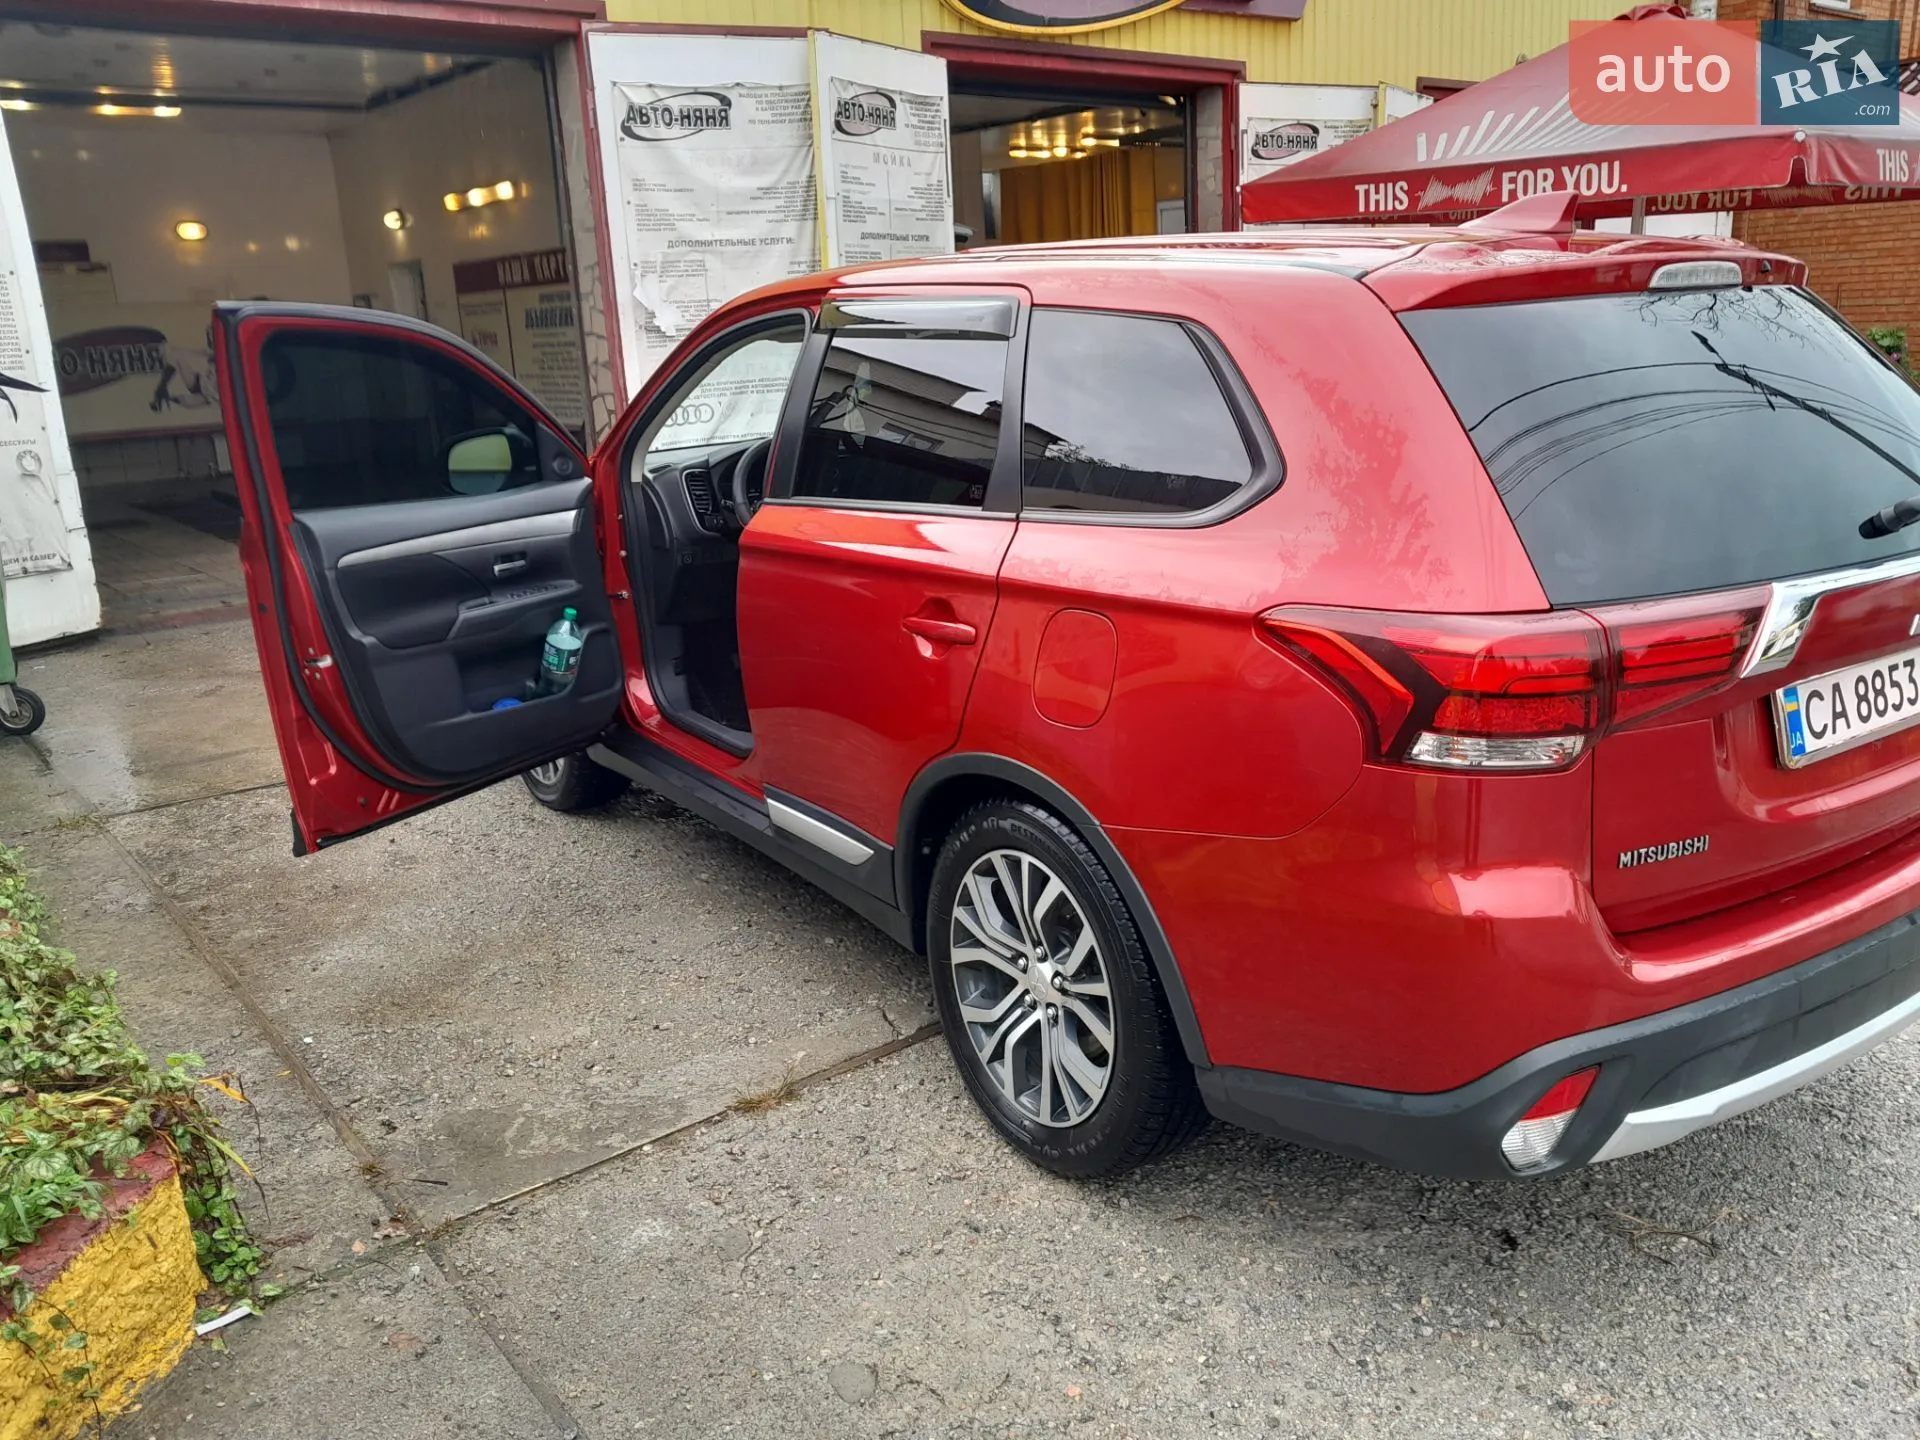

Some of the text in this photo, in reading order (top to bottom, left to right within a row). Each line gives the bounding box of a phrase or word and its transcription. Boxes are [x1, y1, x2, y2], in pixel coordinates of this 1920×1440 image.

[625, 103, 731, 129] АВТО-НЯНЯ
[836, 97, 896, 130] АВТО-НЯНЯ
[1254, 132, 1318, 151] АВТО-НЯНЯ
[1876, 149, 1909, 183] THIS
[1354, 159, 1628, 213] THIS FOR YOU.
[667, 237, 756, 249] ДОПОЛНИТЕЛЬНЫЕ
[1805, 657, 1919, 740] CA 8853
[1618, 834, 1710, 869] MITSUBISHI
